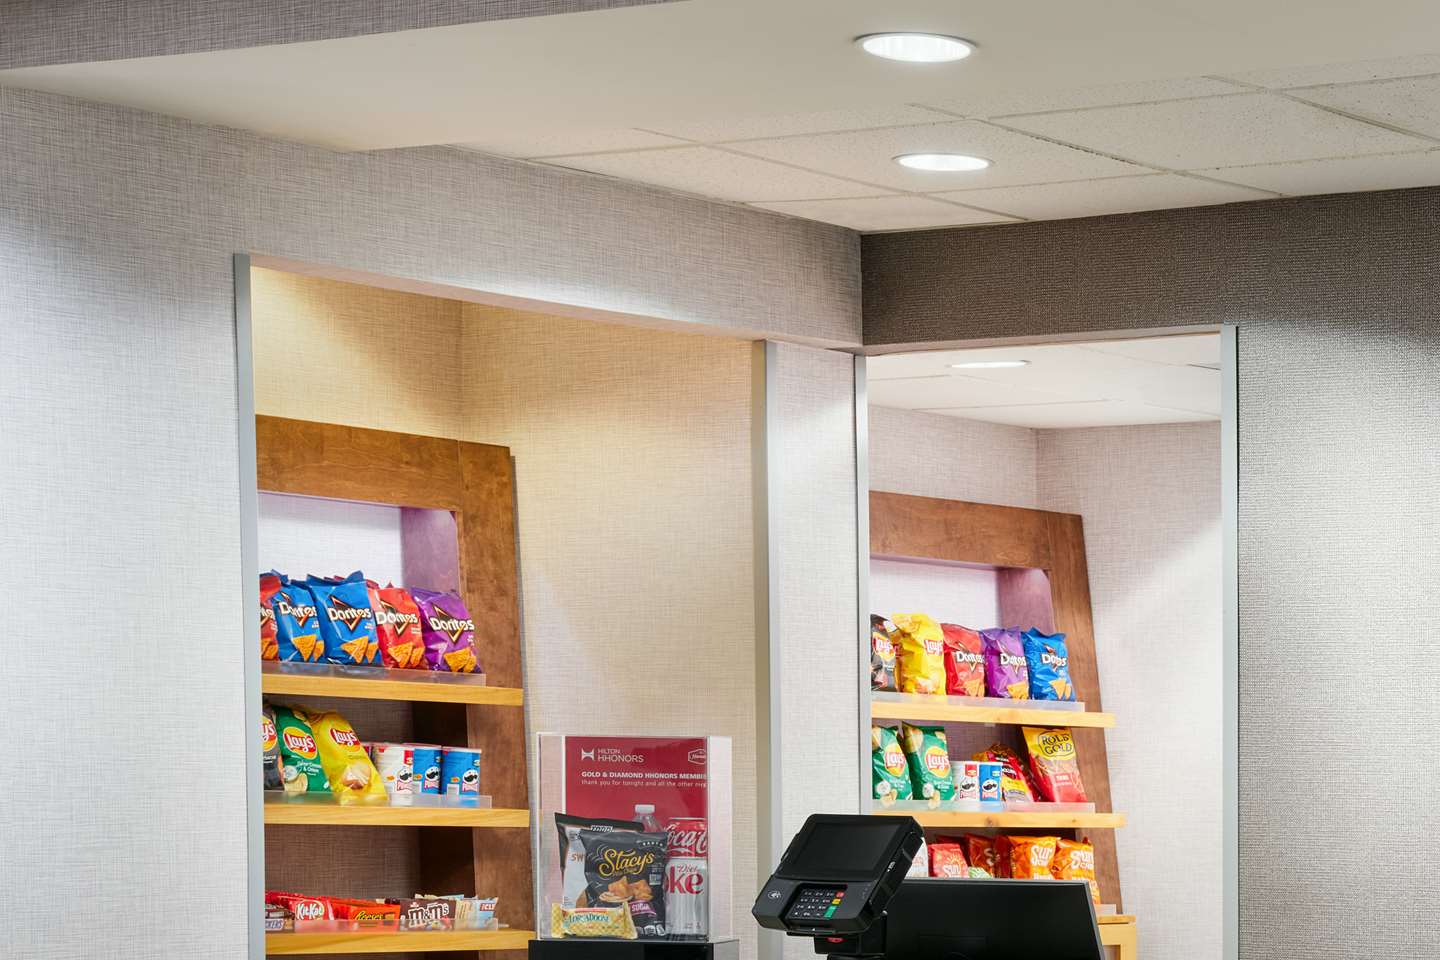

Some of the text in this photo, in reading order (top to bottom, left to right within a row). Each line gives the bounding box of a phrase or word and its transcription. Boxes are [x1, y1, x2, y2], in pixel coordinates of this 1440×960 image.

[328, 607, 372, 621] Doritos
[374, 611, 418, 625] Doritos
[430, 616, 475, 631] Doritos
[286, 732, 314, 752] Lay's
[332, 729, 358, 747] Lay's
[1042, 733, 1070, 746] ROLD
[1044, 742, 1073, 755] GOLD
[597, 754, 645, 763] HHONORS
[609, 771, 643, 779] DIAMOND
[599, 848, 655, 877] Stacy's
[666, 864, 704, 895] ke
